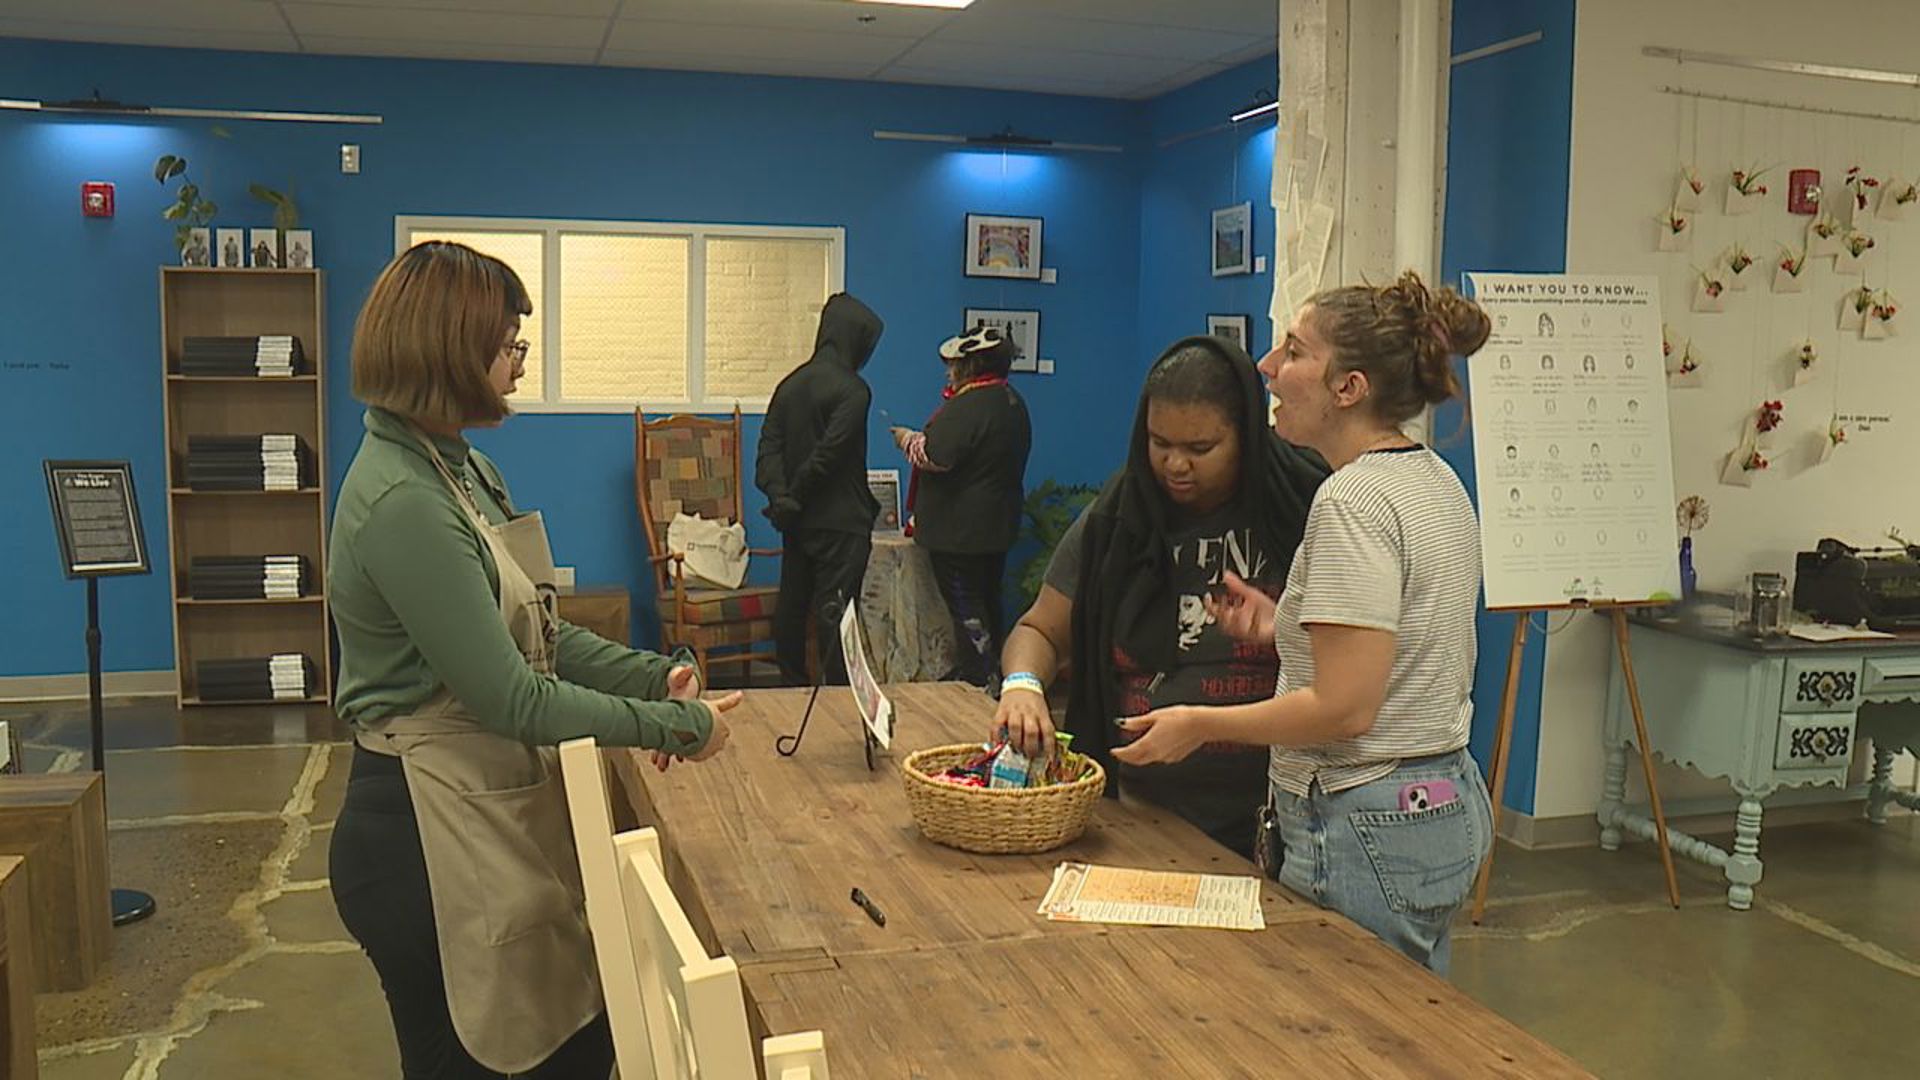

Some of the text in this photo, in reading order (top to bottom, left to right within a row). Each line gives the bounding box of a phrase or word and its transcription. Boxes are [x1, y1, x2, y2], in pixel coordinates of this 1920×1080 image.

[1493, 284, 1534, 294] WANT
[1540, 284, 1567, 294] YOU
[1572, 284, 1589, 295] TO
[1595, 284, 1649, 296] KNOW...
